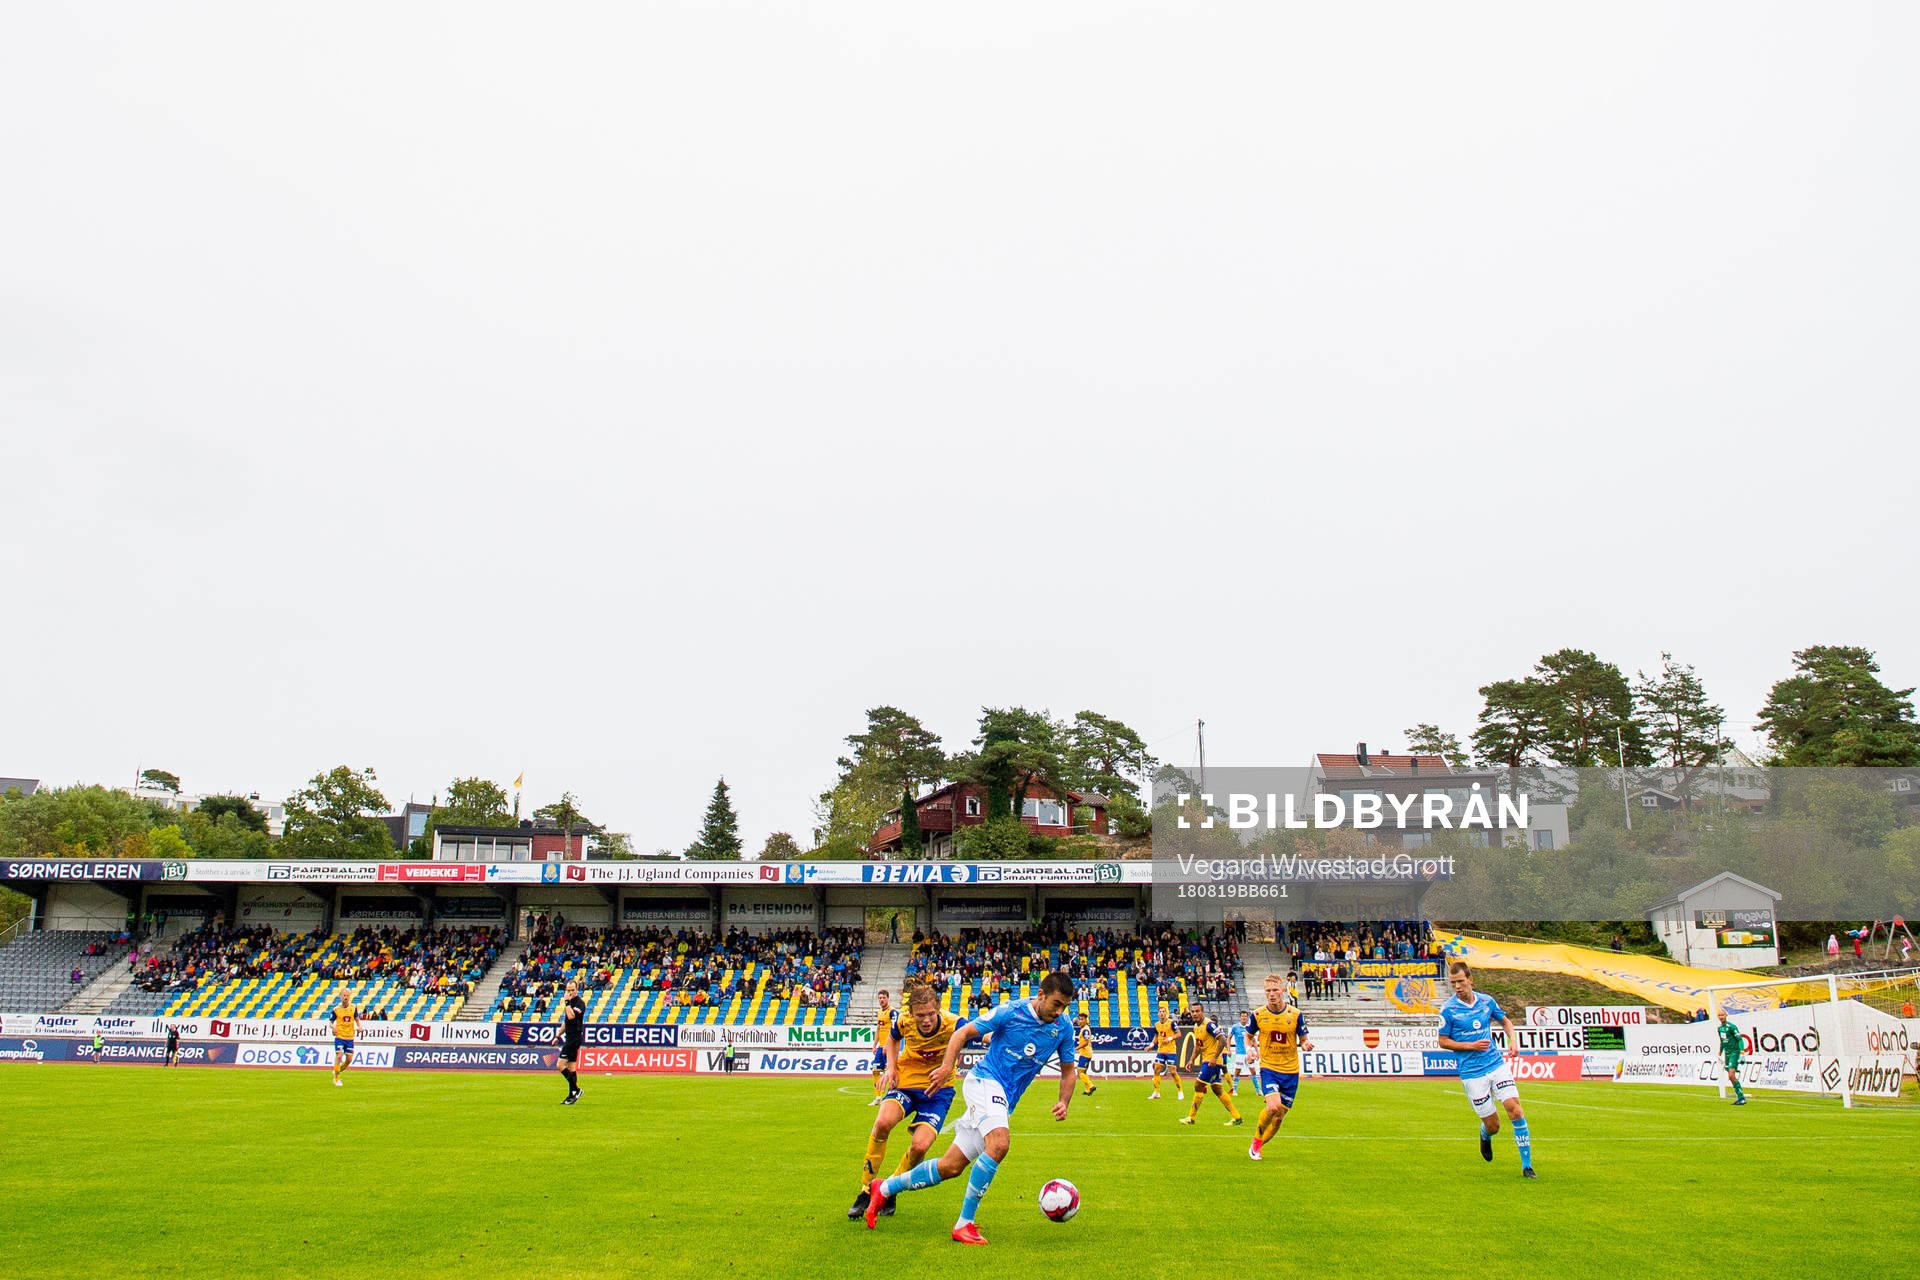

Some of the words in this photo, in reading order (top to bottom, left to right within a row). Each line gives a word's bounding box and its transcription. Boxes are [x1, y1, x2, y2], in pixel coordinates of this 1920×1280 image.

[8, 863, 142, 880] SØRMEGLEREN
[405, 868, 459, 878] VEIDEKKE
[571, 868, 580, 878] U
[590, 868, 614, 880] The
[617, 868, 634, 881] J.J.
[637, 868, 681, 882] Ugland
[684, 868, 754, 882] Companies
[767, 868, 776, 878] U
[871, 865, 942, 882] BEMA
[729, 904, 813, 914] BA-EIENDOM
[36, 1016, 79, 1027] Agder
[94, 1018, 136, 1029] Agder
[165, 1024, 198, 1034] NMO
[216, 1024, 225, 1034] U
[235, 1024, 259, 1036] The
[262, 1024, 280, 1038] J.J.
[282, 1025, 327, 1039] Ugland
[332, 1026, 404, 1040] panies
[415, 1028, 424, 1038] U
[455, 1029, 490, 1039] NYMO
[527, 1027, 675, 1044] SØREGLEREN
[681, 1028, 716, 1043] Grimstad
[788, 1027, 877, 1042] NaturM
[77, 1044, 175, 1058] SPREBANKEN
[176, 1047, 205, 1059] SØR
[242, 1050, 292, 1063] OBOS
[325, 1051, 389, 1065] LAEN
[1641, 1045, 1711, 1056] garasjer.no
[404, 1051, 506, 1065] SPAREBANKEN
[510, 1053, 539, 1065] SØR
[584, 1053, 687, 1068] SKALAHUS
[760, 1053, 849, 1071] Norsafe
[1765, 1058, 1788, 1076] Agder
[1848, 1059, 1900, 1092] umbro
